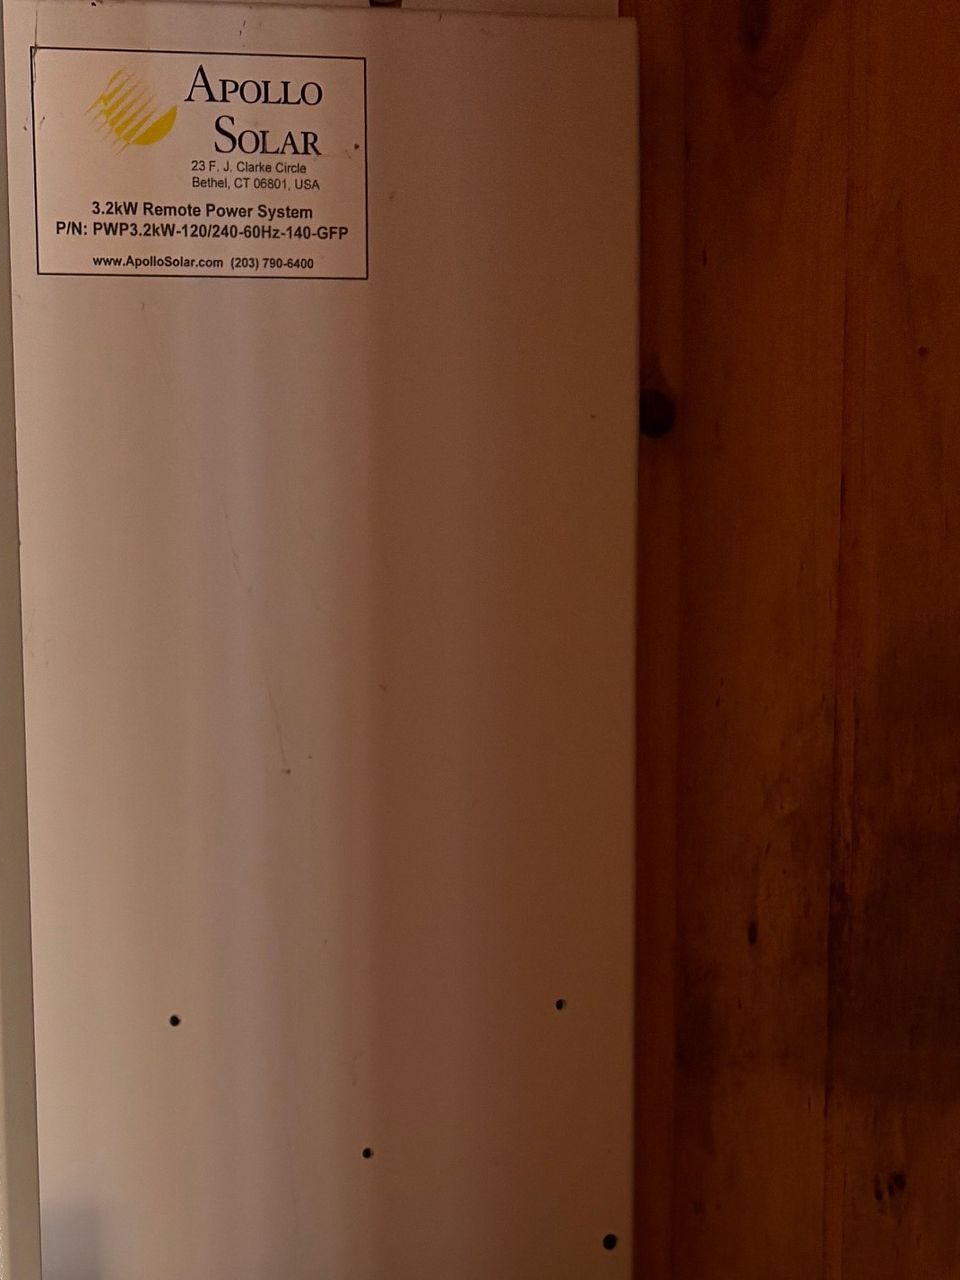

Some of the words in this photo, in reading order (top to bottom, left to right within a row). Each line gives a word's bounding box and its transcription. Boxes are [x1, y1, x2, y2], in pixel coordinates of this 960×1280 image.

[184, 64, 323, 105] APOLLO
[214, 115, 322, 156] SOLAR
[191, 160, 206, 172] 23
[208, 161, 220, 172] F.
[223, 161, 233, 173] J.
[236, 161, 272, 174] Clarke
[275, 162, 307, 174] Circle
[192, 176, 230, 191] Bethel,
[234, 177, 251, 189] CT
[253, 178, 291, 192] 06801,
[295, 179, 320, 190] USA
[91, 201, 138, 217] 3.2kW
[143, 202, 201, 217] Remote
[205, 203, 253, 218] Power
[257, 204, 313, 221] System
[56, 221, 87, 236] P/N:
[93, 222, 348, 240] PWP3.2kW-120/240-60Hz-140-GFP
[92, 256, 224, 270] www.ApolloSolar.com
[230, 258, 260, 271] (203)
[263, 258, 314, 270] 790-6400
